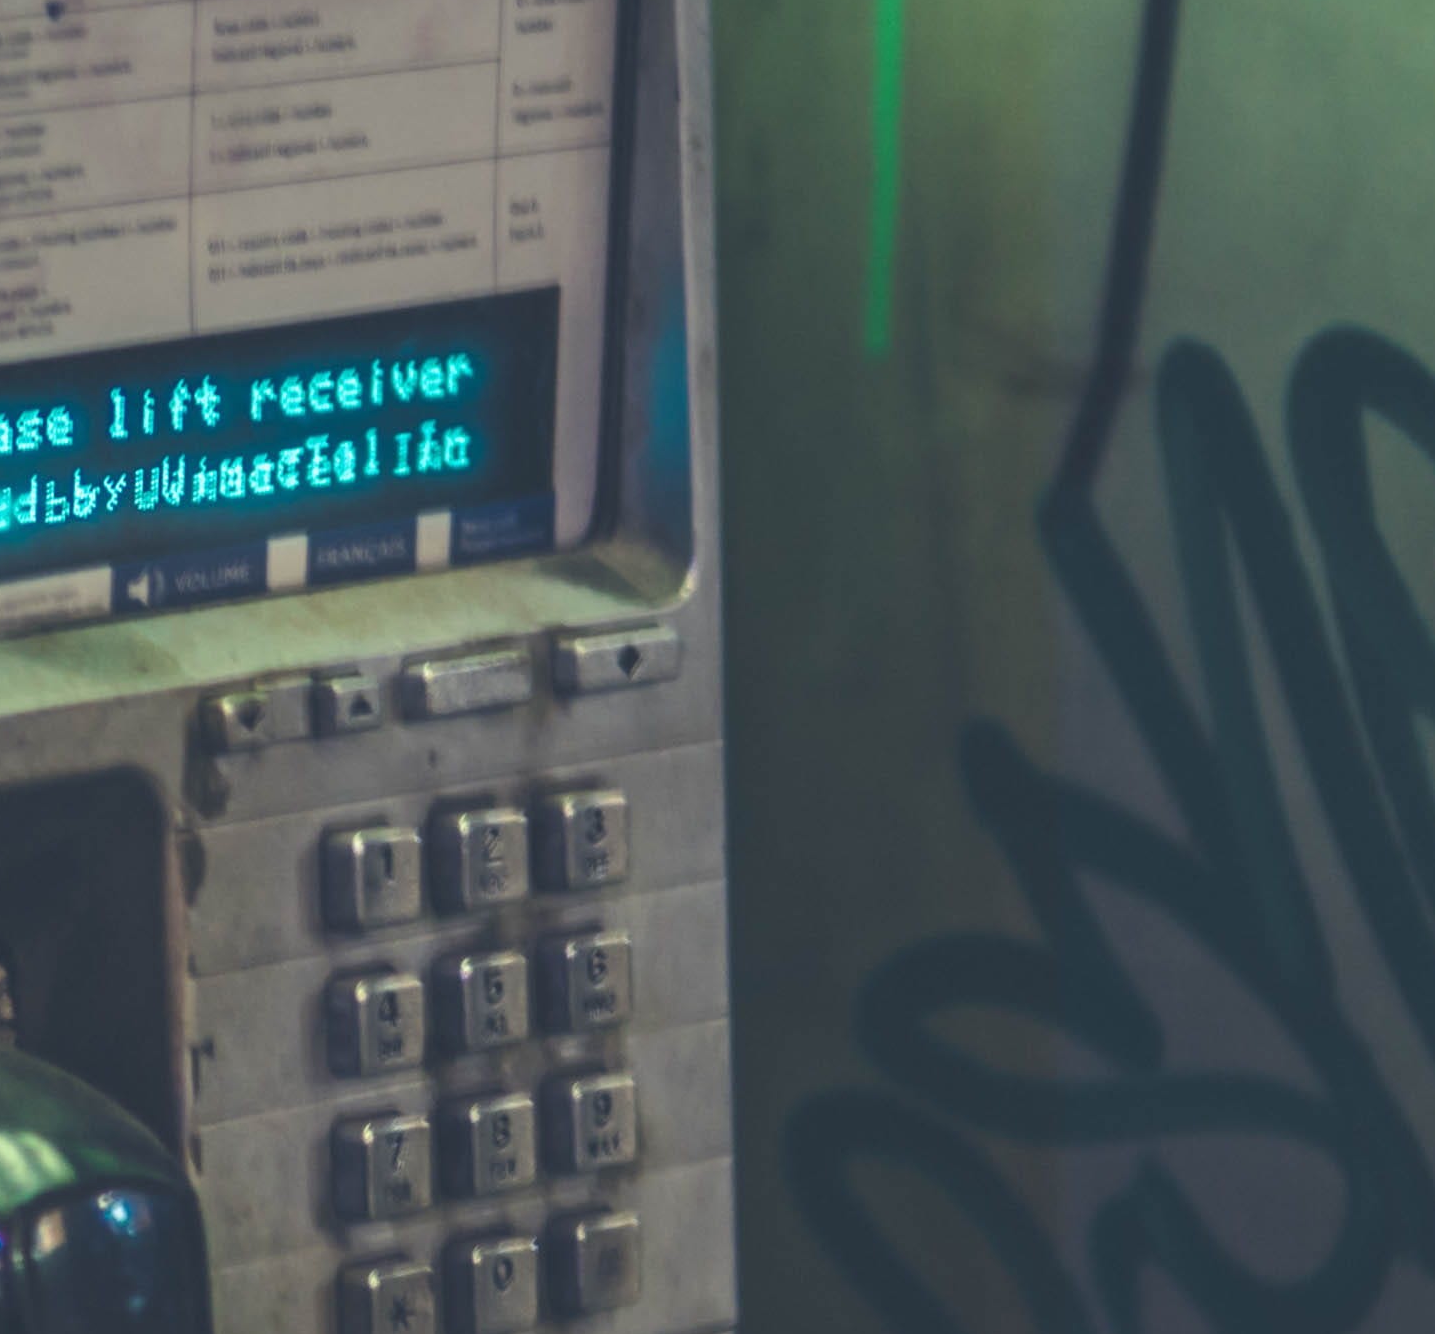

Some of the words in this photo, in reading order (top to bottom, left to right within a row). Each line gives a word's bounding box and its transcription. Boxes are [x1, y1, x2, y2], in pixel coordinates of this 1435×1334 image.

[109, 374, 222, 440] lift
[250, 352, 475, 423] receiver
[585, 805, 606, 843] 3
[482, 824, 505, 864] 2
[586, 948, 608, 985] 6
[482, 969, 504, 1005] 5
[380, 990, 400, 1025] 4
[592, 1090, 613, 1128] 9
[491, 1114, 511, 1150] 8
[385, 1131, 405, 1171] 7
[492, 1255, 514, 1292] 0
